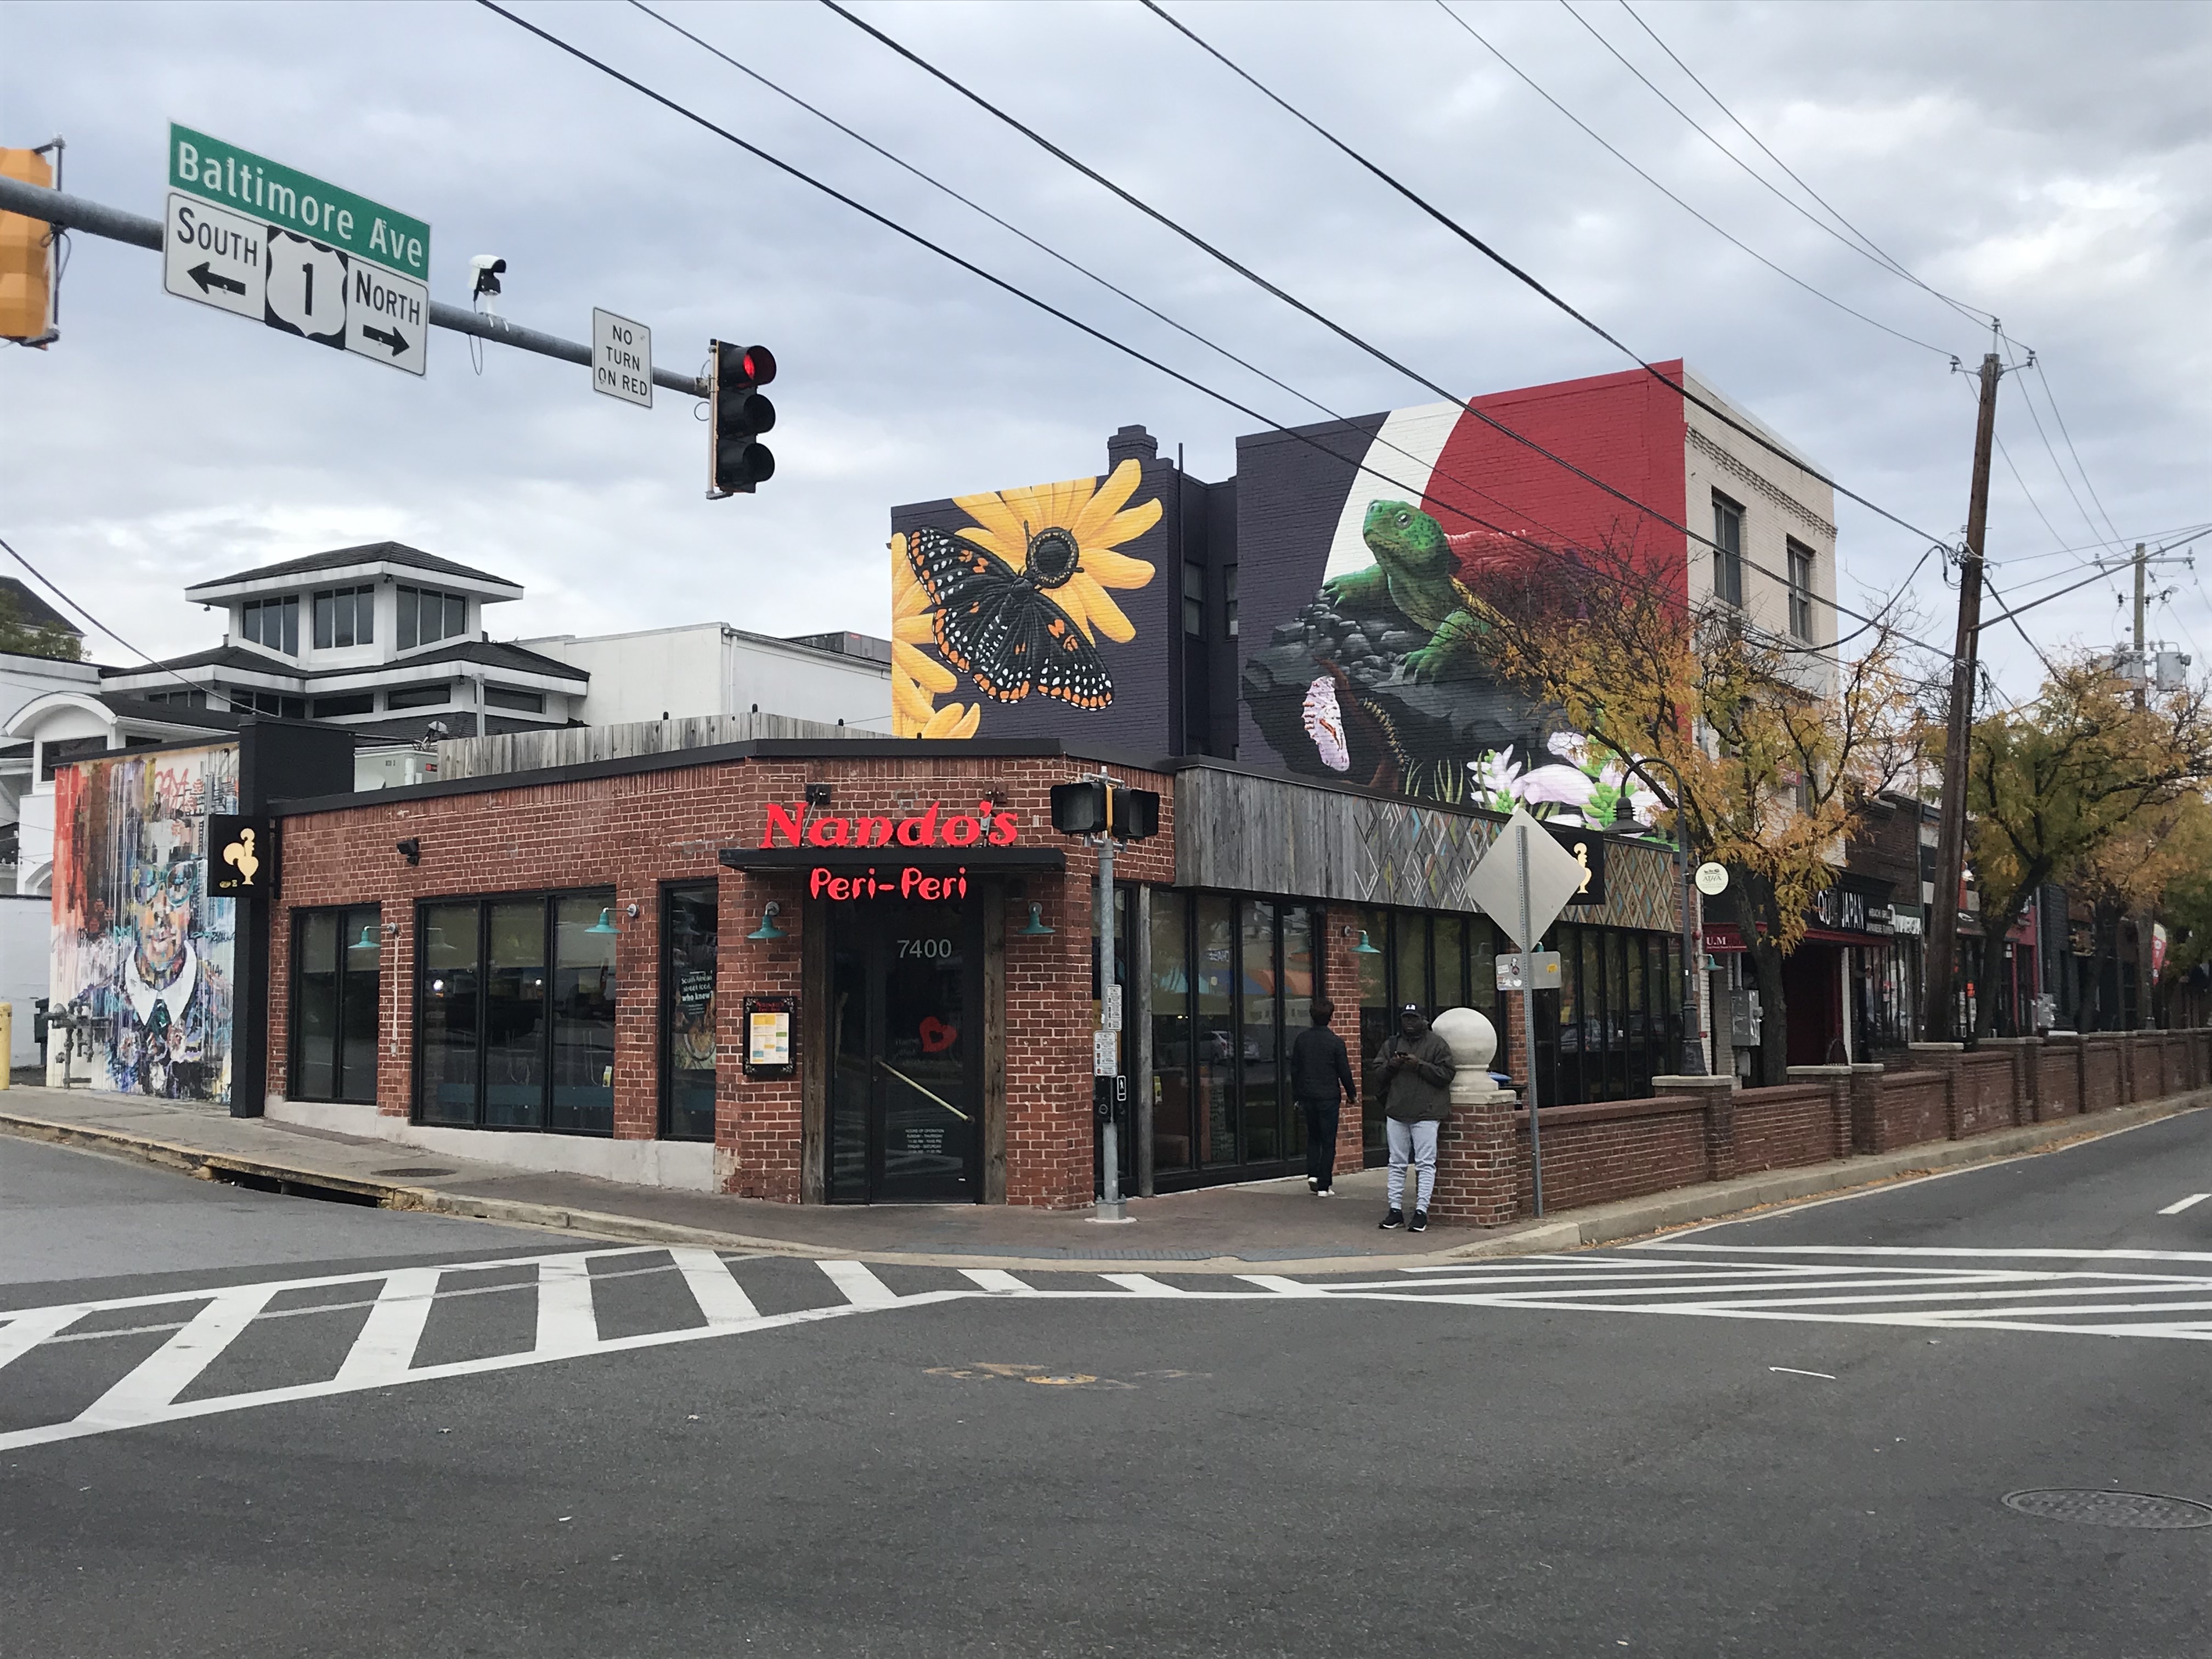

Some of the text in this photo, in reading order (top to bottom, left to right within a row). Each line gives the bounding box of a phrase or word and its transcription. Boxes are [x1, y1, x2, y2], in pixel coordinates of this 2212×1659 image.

[179, 142, 422, 268] Baltimore Ave
[177, 207, 258, 267] SOUTH
[302, 263, 314, 317] 1
[356, 270, 420, 326] NORTH
[613, 325, 633, 346] NO
[606, 346, 640, 372] TURN
[598, 367, 647, 396] ON RED
[759, 800, 1019, 849] Nando's
[810, 866, 967, 901] Peri-Peri
[1841, 891, 1864, 930] JAPAN
[897, 939, 952, 958] 7400
[682, 990, 714, 1001] who knew?
